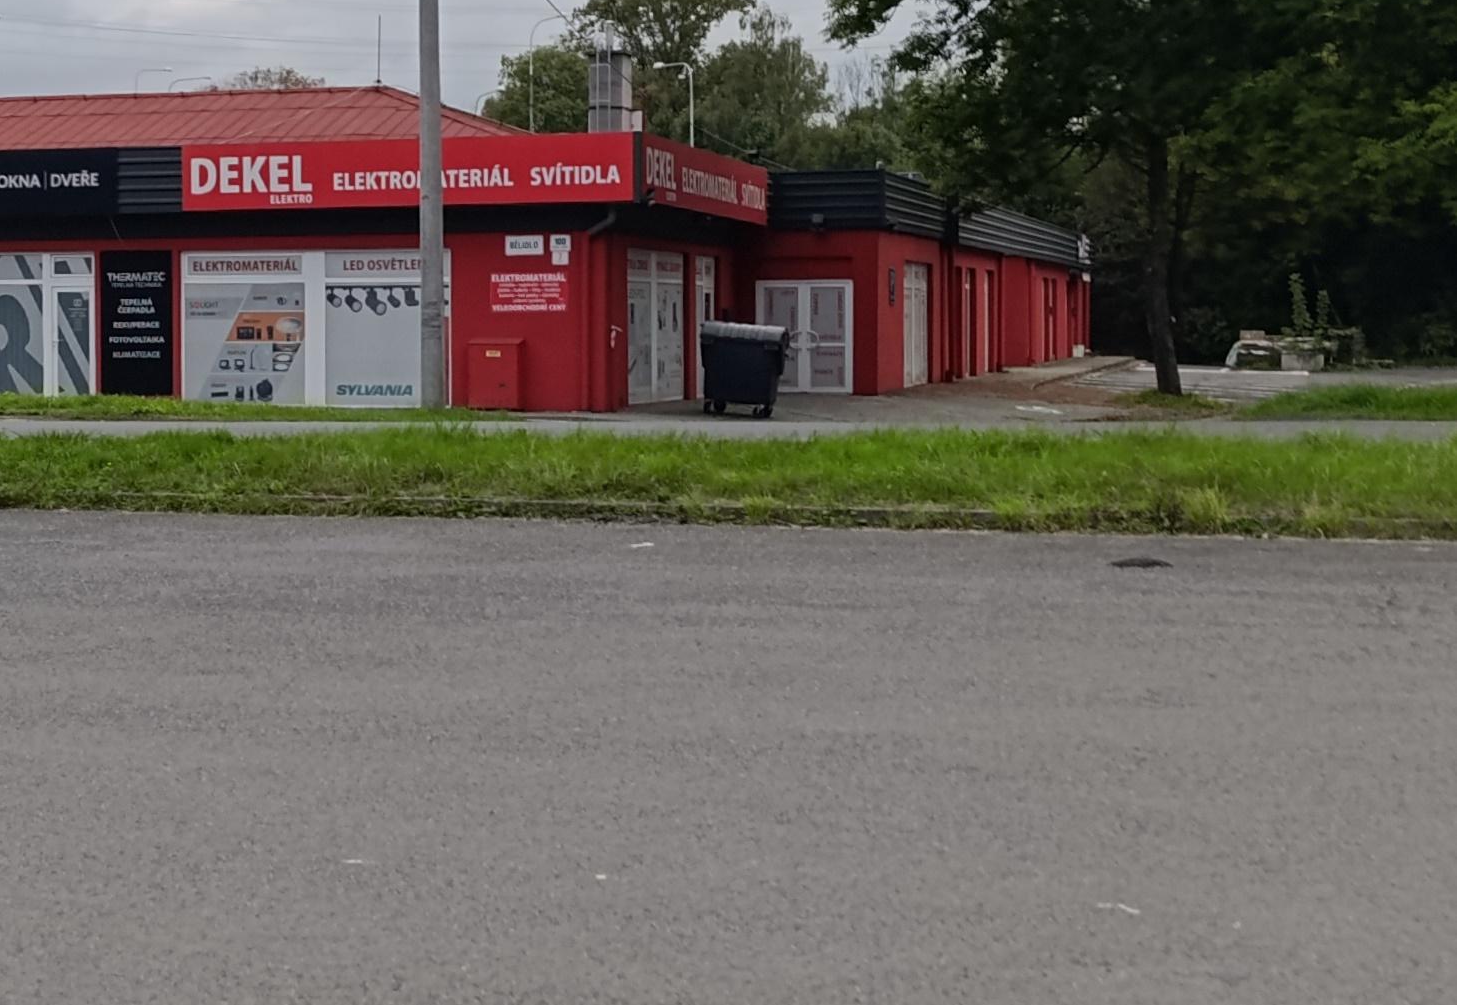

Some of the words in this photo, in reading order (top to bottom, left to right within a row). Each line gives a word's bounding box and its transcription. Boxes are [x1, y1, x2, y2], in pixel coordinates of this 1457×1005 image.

[190, 155, 313, 195] DEKEL
[646, 146, 677, 190] DEKEL
[50, 170, 99, 188] DVEŘE
[333, 164, 514, 191] ELEKTROATERIÁL
[530, 162, 621, 187] SVÍTIDLA
[682, 166, 738, 205] ELEKTROMATERIÁL
[270, 194, 313, 205] ELEKTRO
[193, 257, 298, 272] ELEKTROMATERIÁL
[343, 259, 363, 271] LED
[368, 256, 422, 271] OSVĚTLE
[107, 271, 166, 282] THERMATEC
[108, 336, 166, 344] FOTOVOLTAIKA
[336, 384, 413, 397] SYLVANIA
